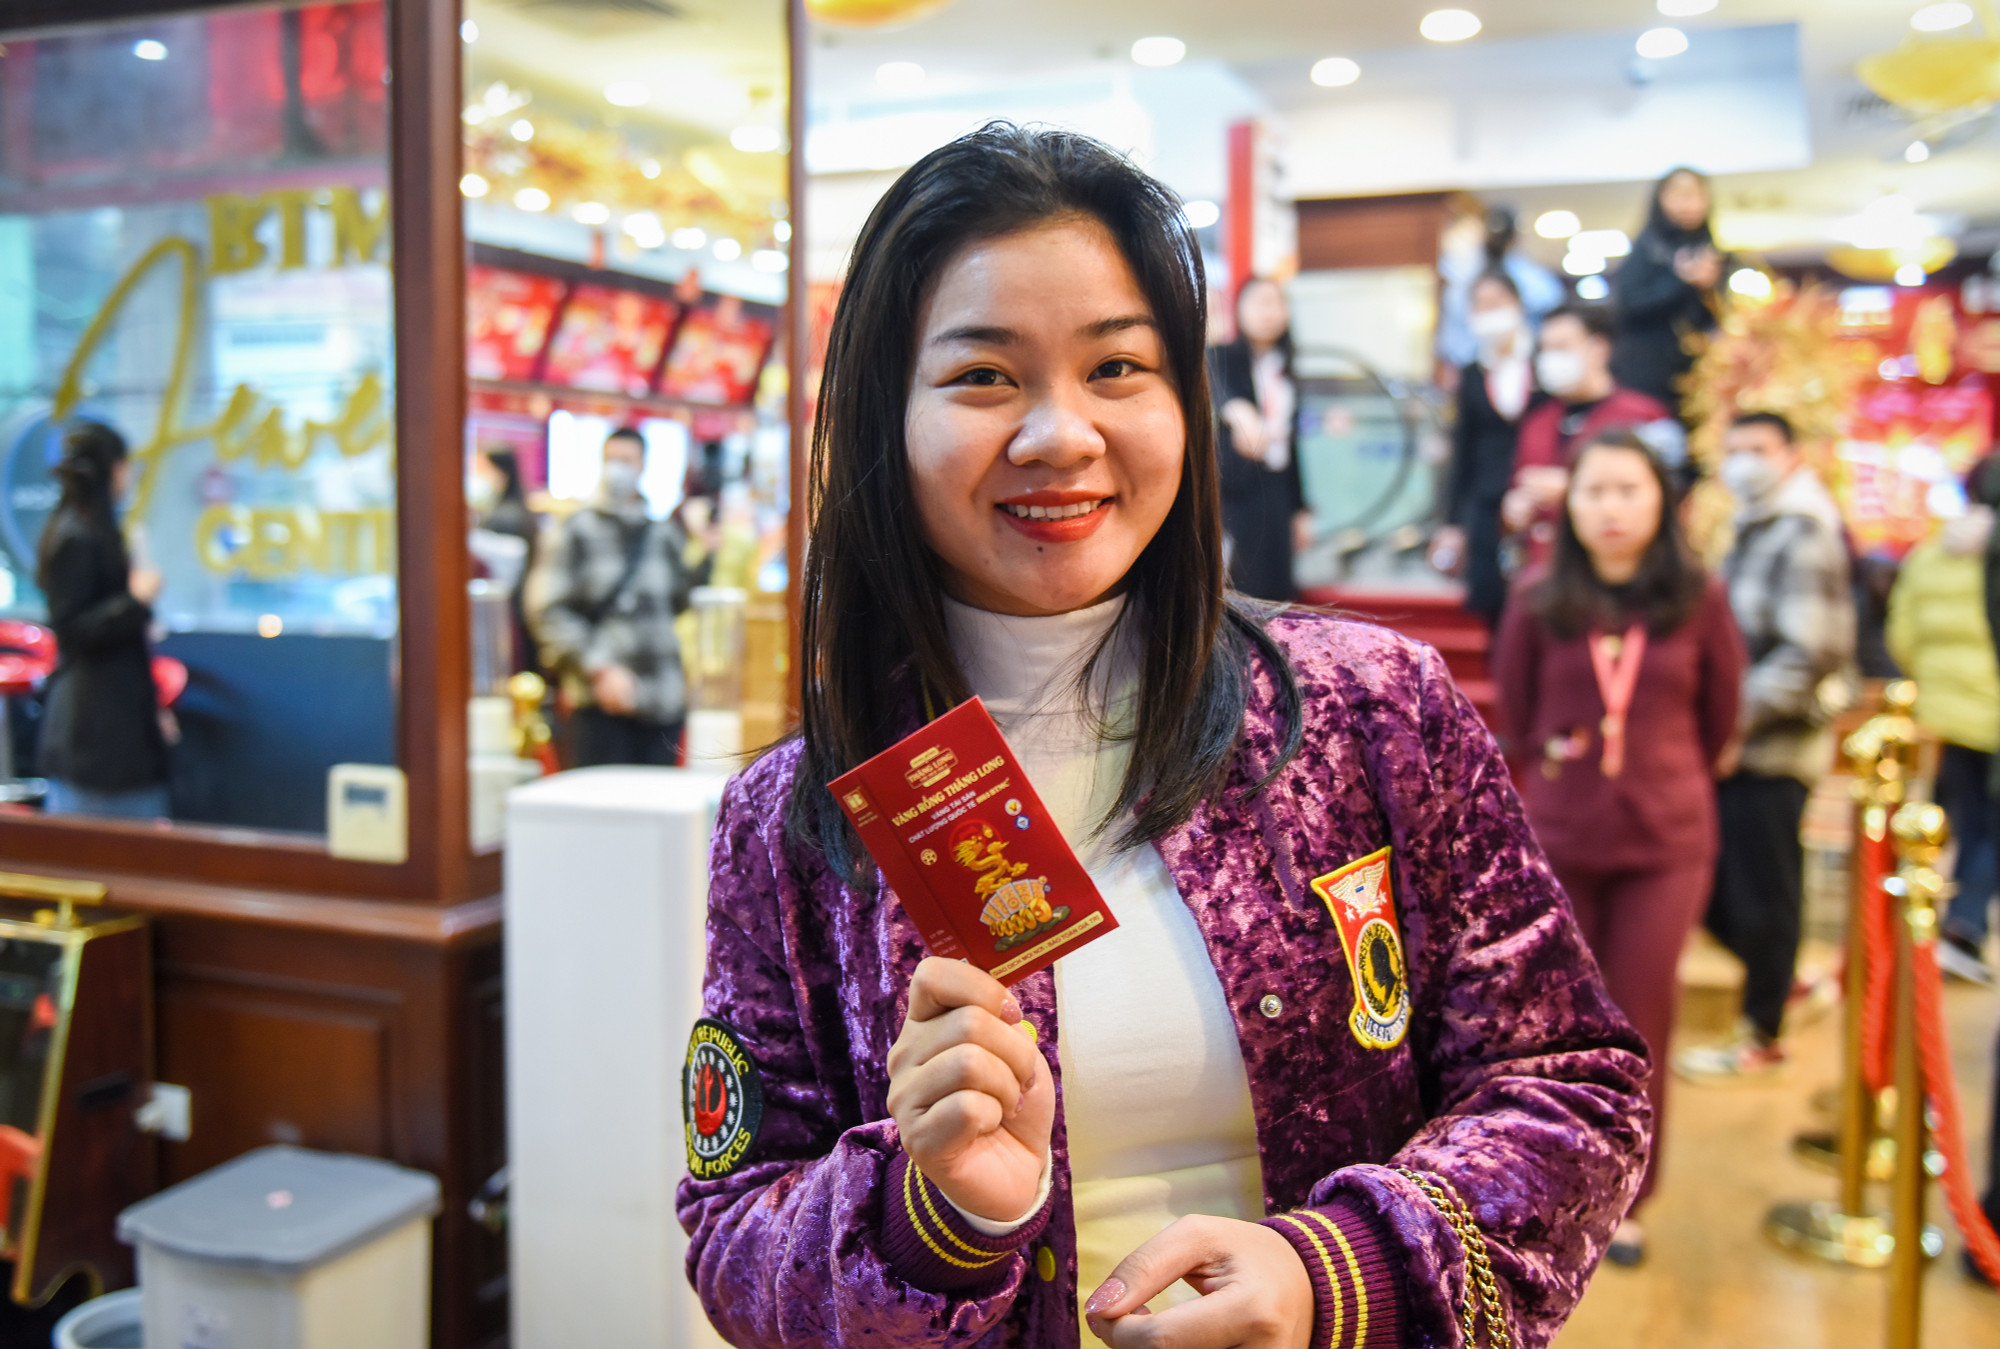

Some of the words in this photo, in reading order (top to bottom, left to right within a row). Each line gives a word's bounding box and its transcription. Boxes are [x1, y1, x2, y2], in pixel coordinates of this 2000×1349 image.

[979, 755, 1005, 777] LONG
[696, 1025, 749, 1076] REPUBLIC
[705, 1126, 751, 1177] FORCES
